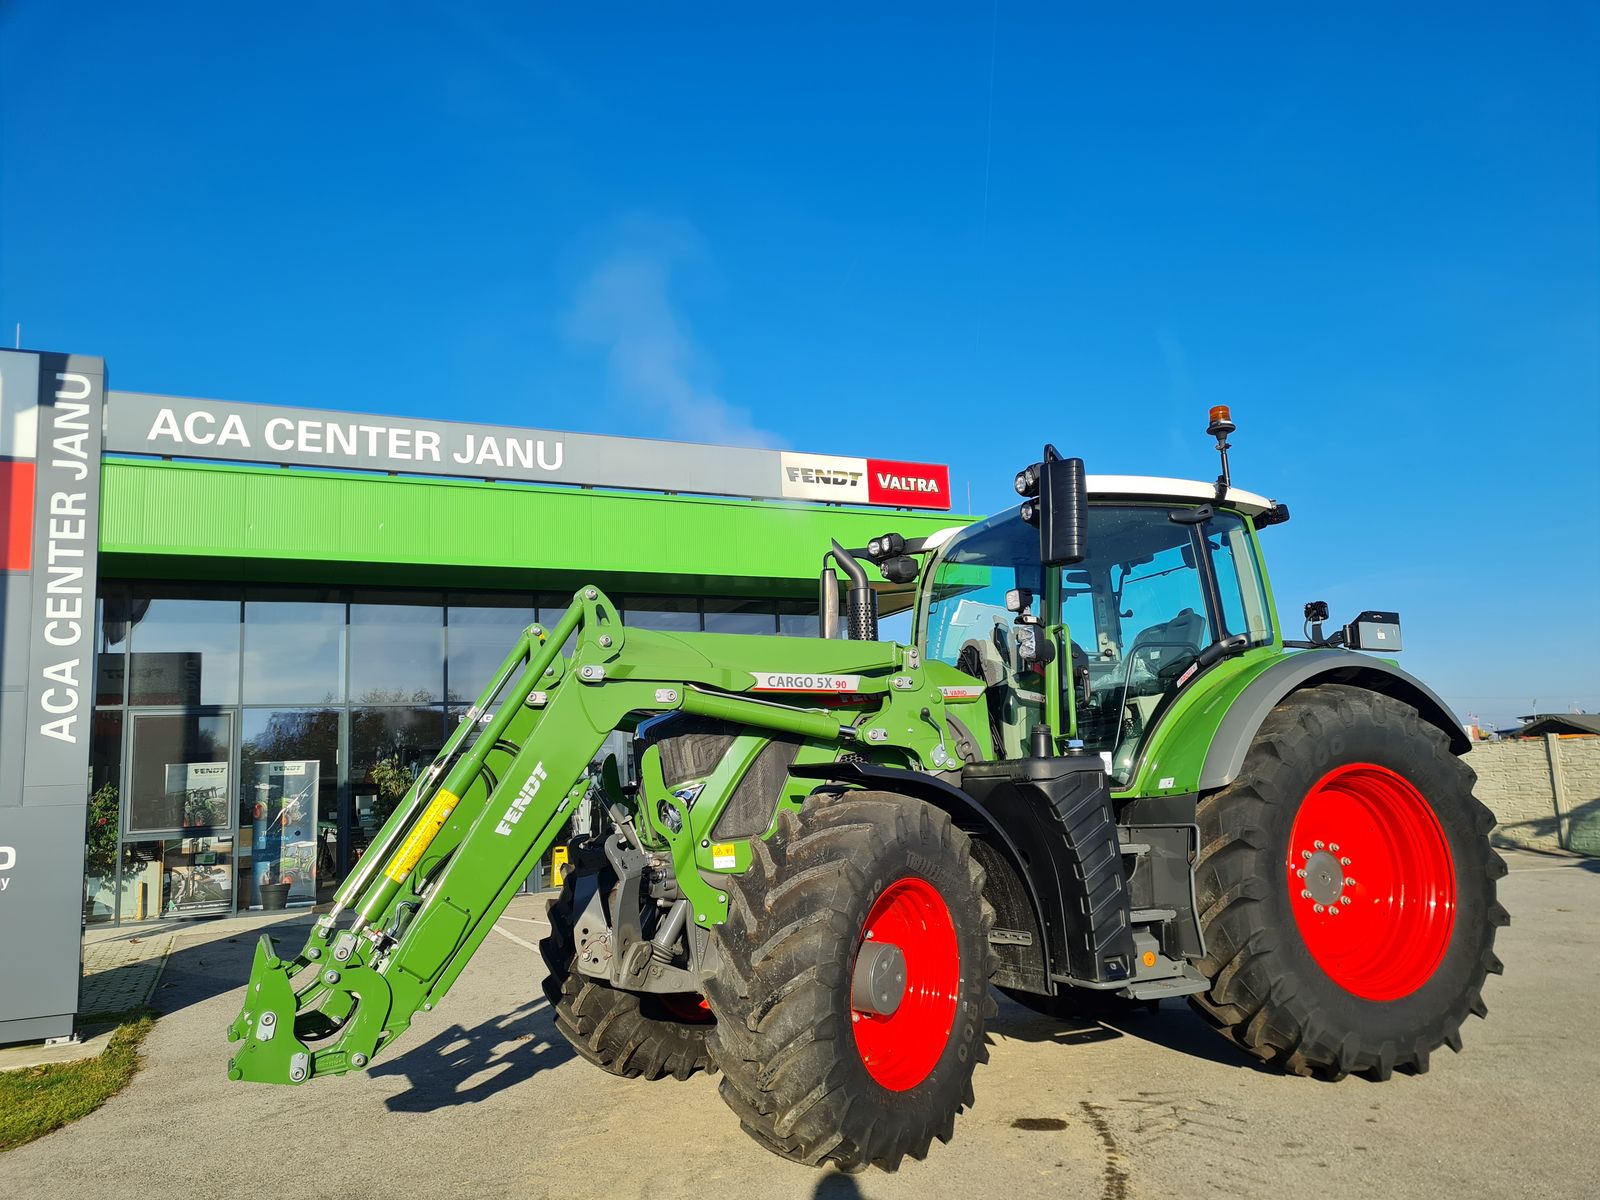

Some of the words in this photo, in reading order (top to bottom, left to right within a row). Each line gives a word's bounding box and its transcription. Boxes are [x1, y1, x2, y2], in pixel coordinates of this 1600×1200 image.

[51, 372, 92, 481] JANU
[146, 408, 251, 448] ACA
[264, 417, 441, 462] CENTER
[453, 434, 564, 471] JANU
[785, 466, 863, 487] FENDT
[876, 472, 940, 493] VALTRA
[44, 491, 86, 646] CENTER
[40, 657, 80, 744] ACA
[767, 675, 813, 689] CARGO
[816, 676, 833, 689] 5X
[835, 679, 847, 689] 90
[193, 767, 226, 775] FENDT
[494, 760, 548, 836] FENDT
